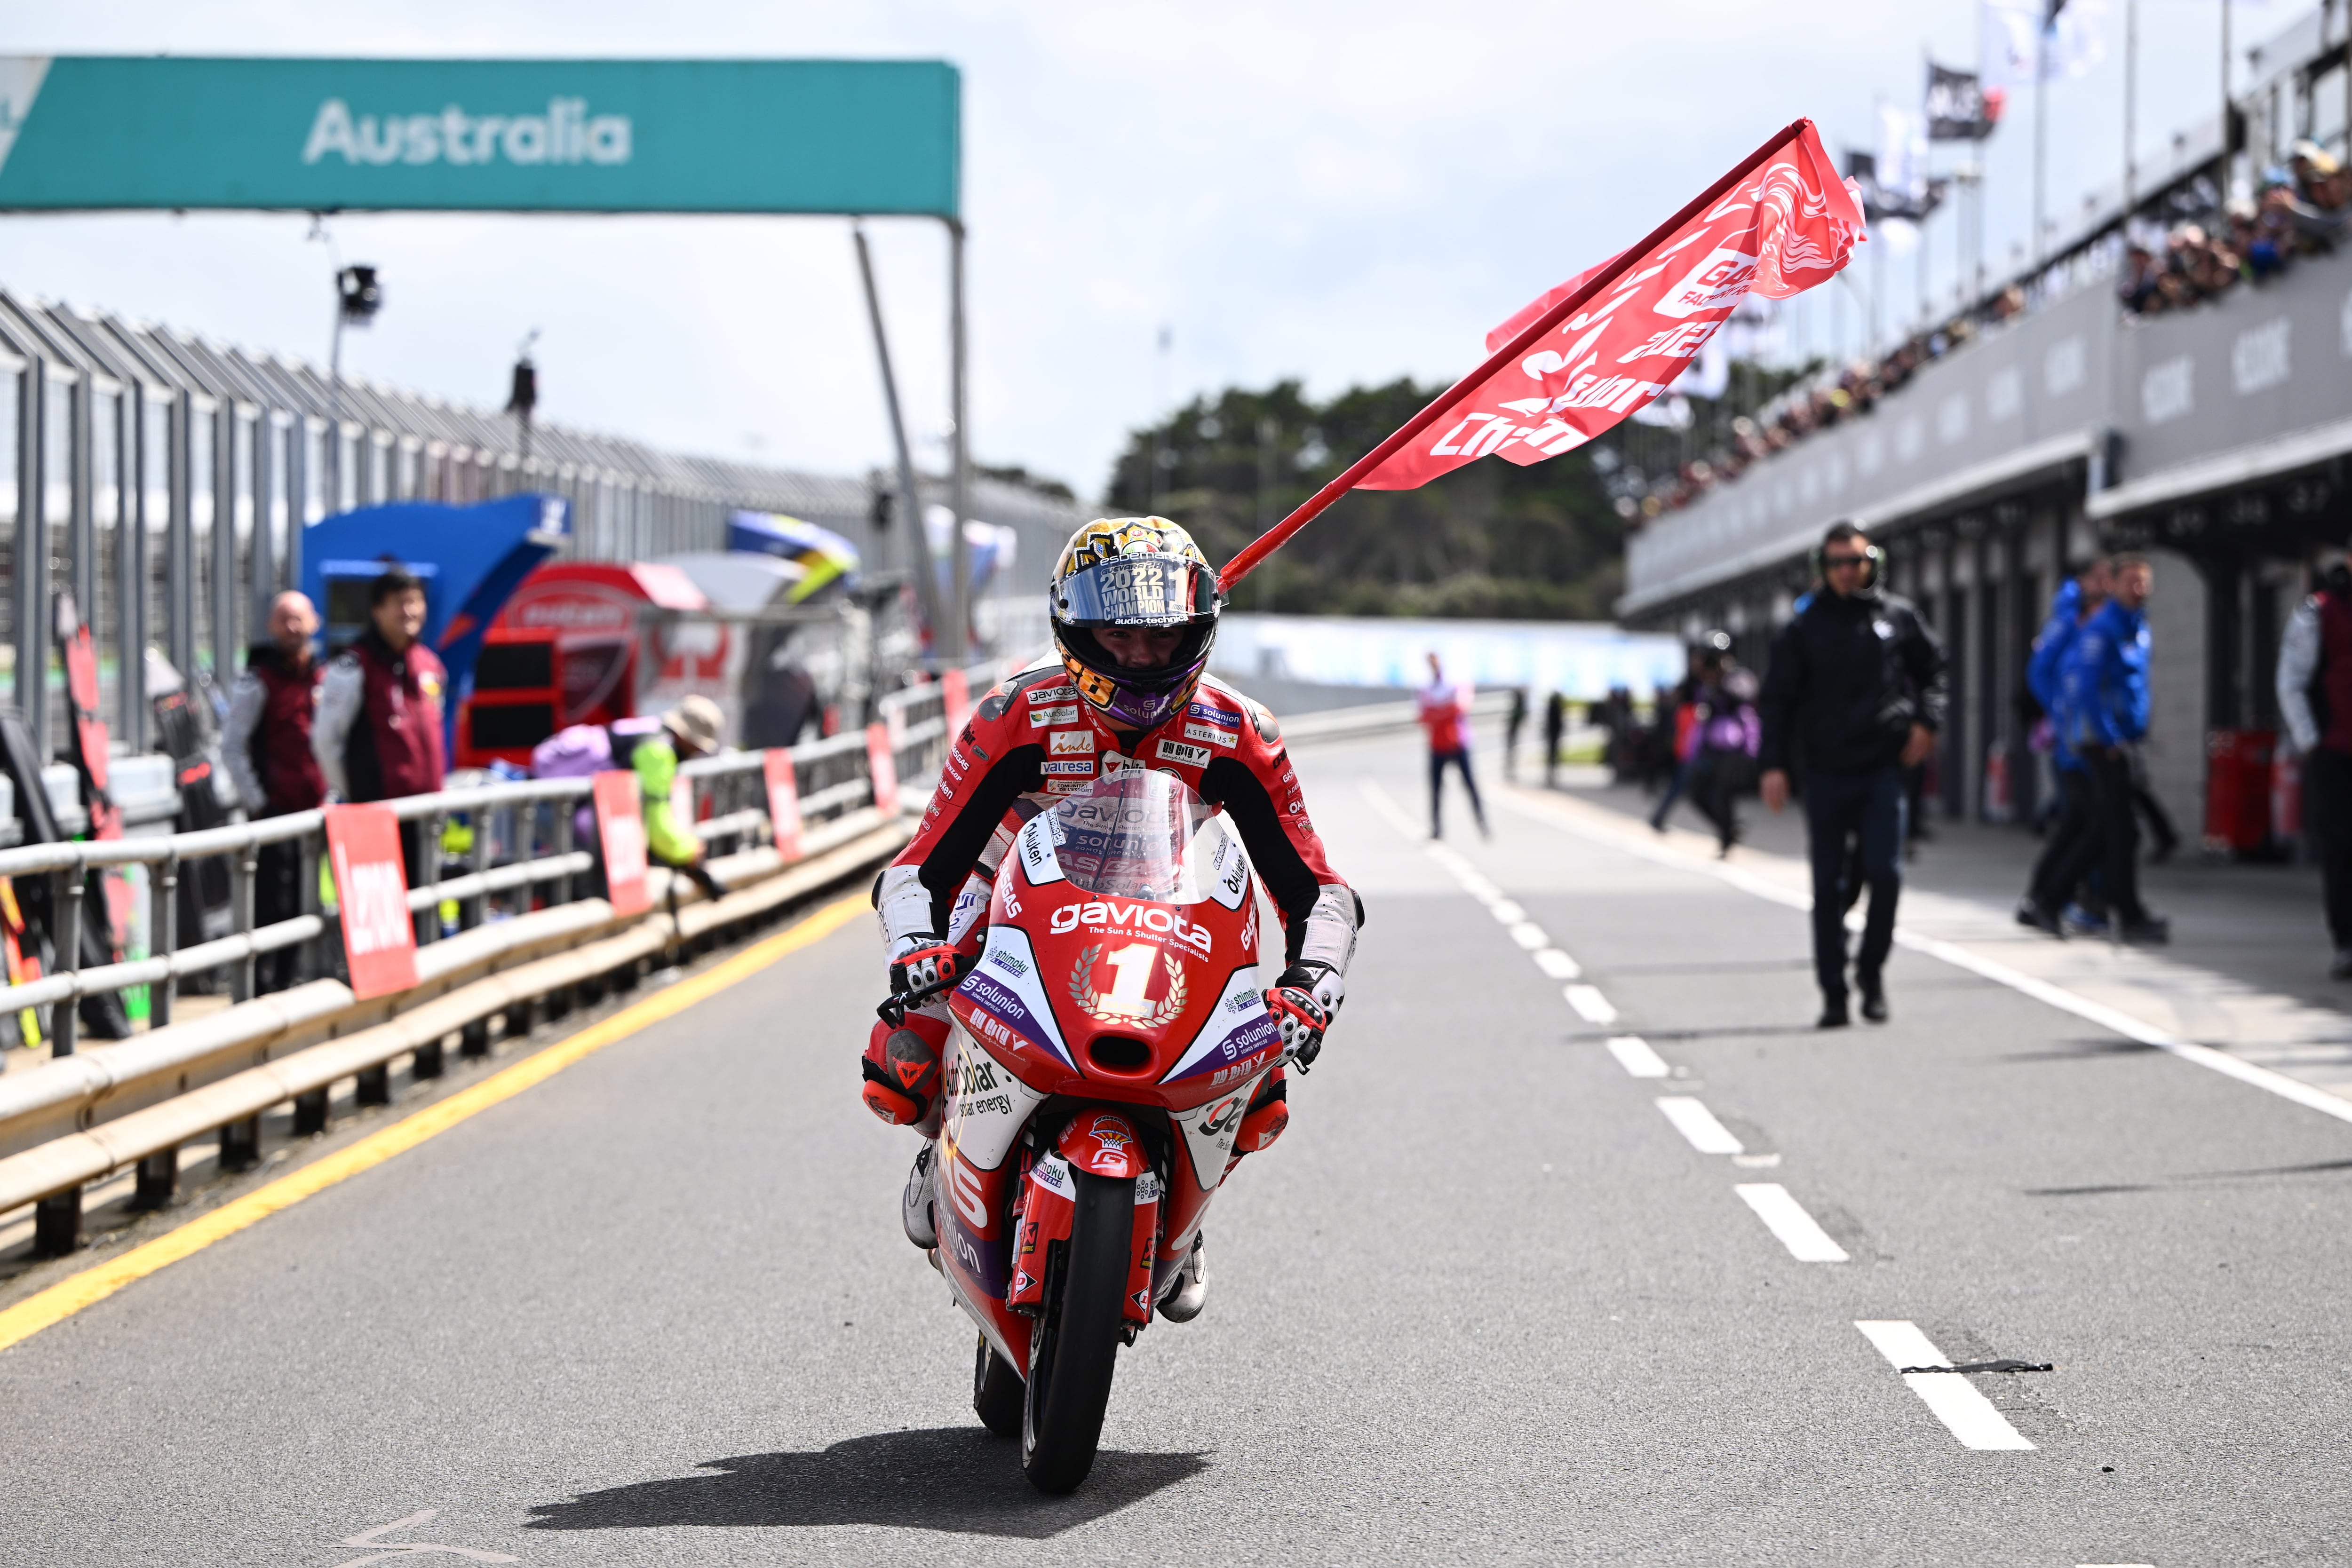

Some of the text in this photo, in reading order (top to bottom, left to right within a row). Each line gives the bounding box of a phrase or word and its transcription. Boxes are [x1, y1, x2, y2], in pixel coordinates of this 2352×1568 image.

[302, 96, 633, 166] Australia
[1101, 562, 1145, 575] GUEVARA
[1100, 569, 1164, 593] 2022
[1101, 586, 1164, 606] WORLD
[1104, 600, 1165, 621] CHAMPION
[1115, 615, 1188, 625] audio-technica
[1029, 688, 1075, 701] gaviota
[1043, 708, 1075, 718] AutoSolar
[1203, 709, 1239, 723] solunion
[1052, 733, 1092, 752] inde
[1185, 729, 1227, 743] ASTERIUS
[1043, 762, 1091, 772] valresa
[1075, 846, 1102, 855] SOMOS
[999, 856, 1022, 919] GASGAS
[1050, 902, 1212, 953] gaviota
[1135, 930, 1167, 943] Shutter
[1169, 939, 1208, 963] Specialists
[996, 950, 1029, 973] shimoku
[1000, 963, 1022, 978] SYSTEMS
[1096, 943, 1157, 1019] 1
[971, 992, 1001, 1013] SOMOS IMPULSO
[976, 982, 1025, 1019] solunion
[1234, 987, 1258, 1005] shimoku
[1236, 1022, 1277, 1049] solunion
[1241, 1039, 1268, 1054] SOMOS IMPULSO
[946, 1051, 998, 1097] AutoSolar
[960, 1094, 1012, 1117] solar energy
